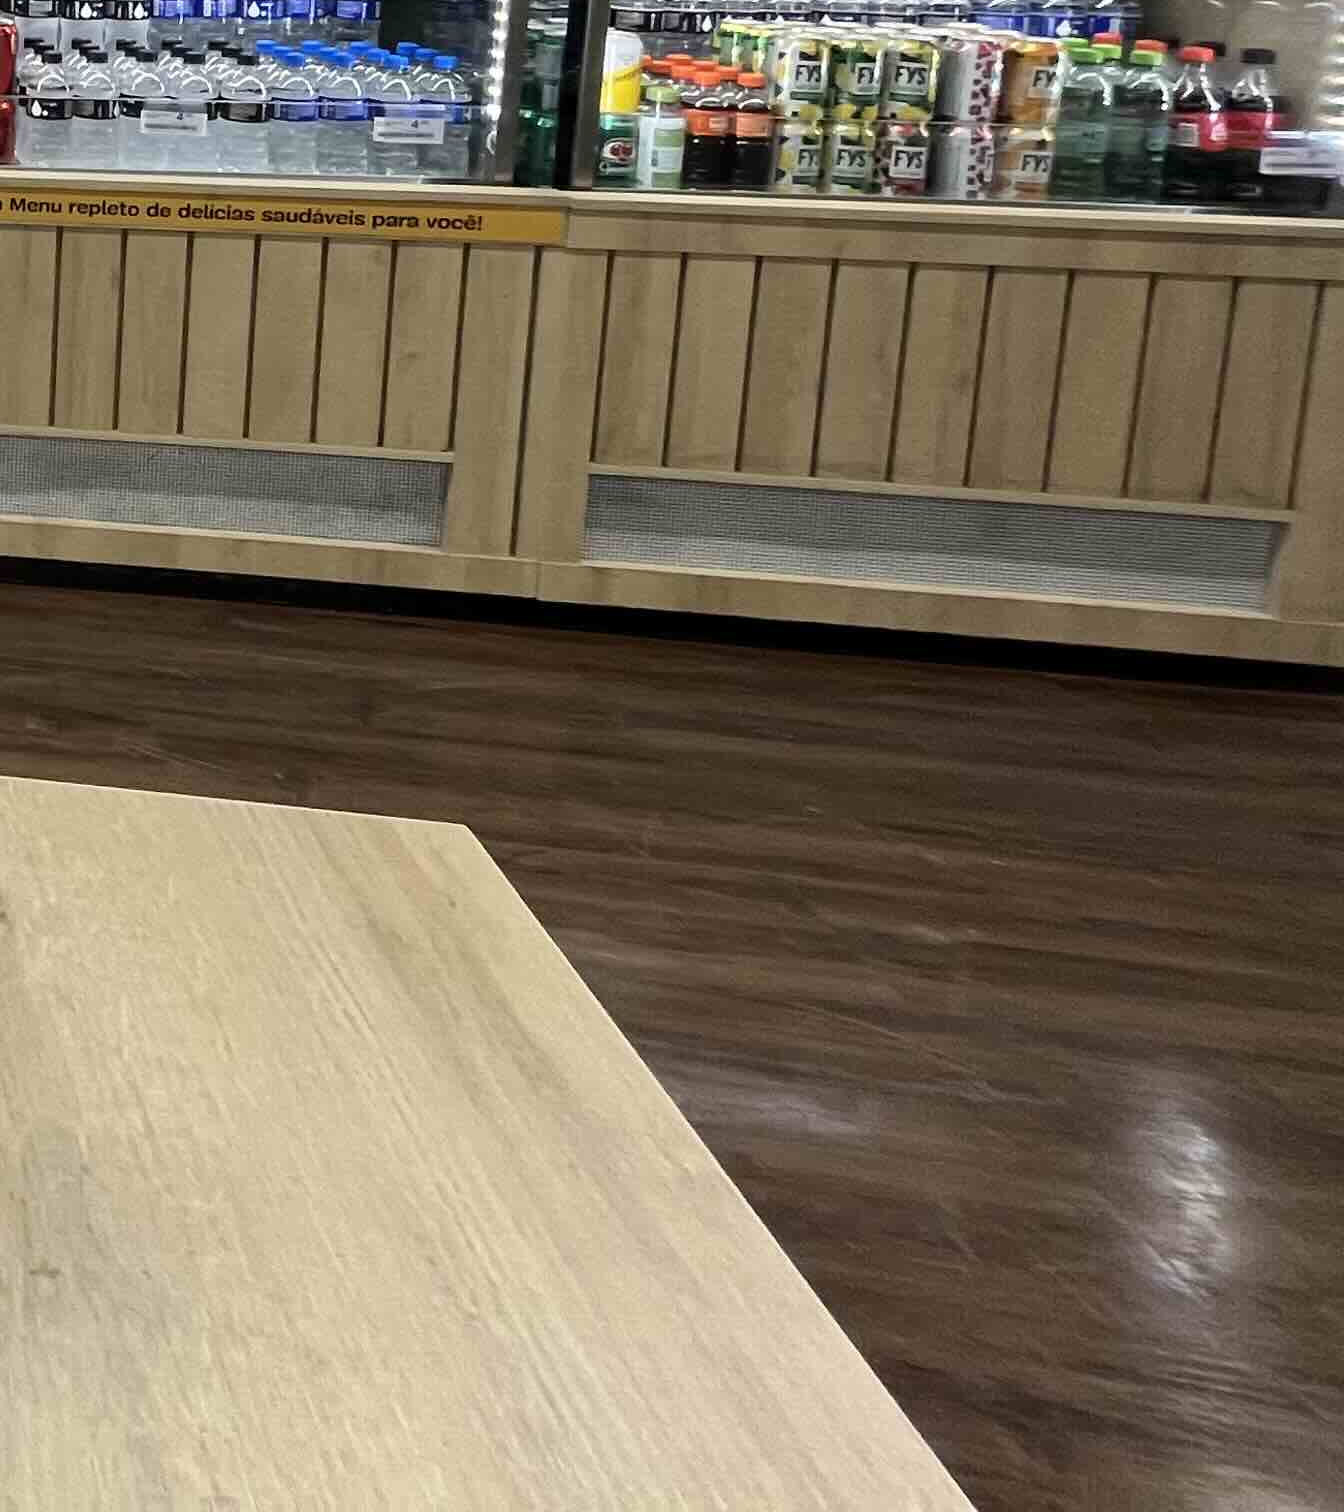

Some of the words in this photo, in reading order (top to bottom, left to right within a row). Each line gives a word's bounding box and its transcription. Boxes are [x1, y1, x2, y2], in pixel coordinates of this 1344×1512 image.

[895, 65, 927, 85] FYS
[1032, 69, 1056, 88] FY
[836, 148, 866, 167] FYS
[894, 149, 924, 169] FYS
[1021, 154, 1051, 173] FYS
[9, 197, 63, 214] Menu
[68, 199, 140, 218] repleto
[146, 202, 172, 218] de
[261, 207, 366, 226] saudáveis
[371, 213, 420, 230] para
[426, 214, 483, 232] você!
